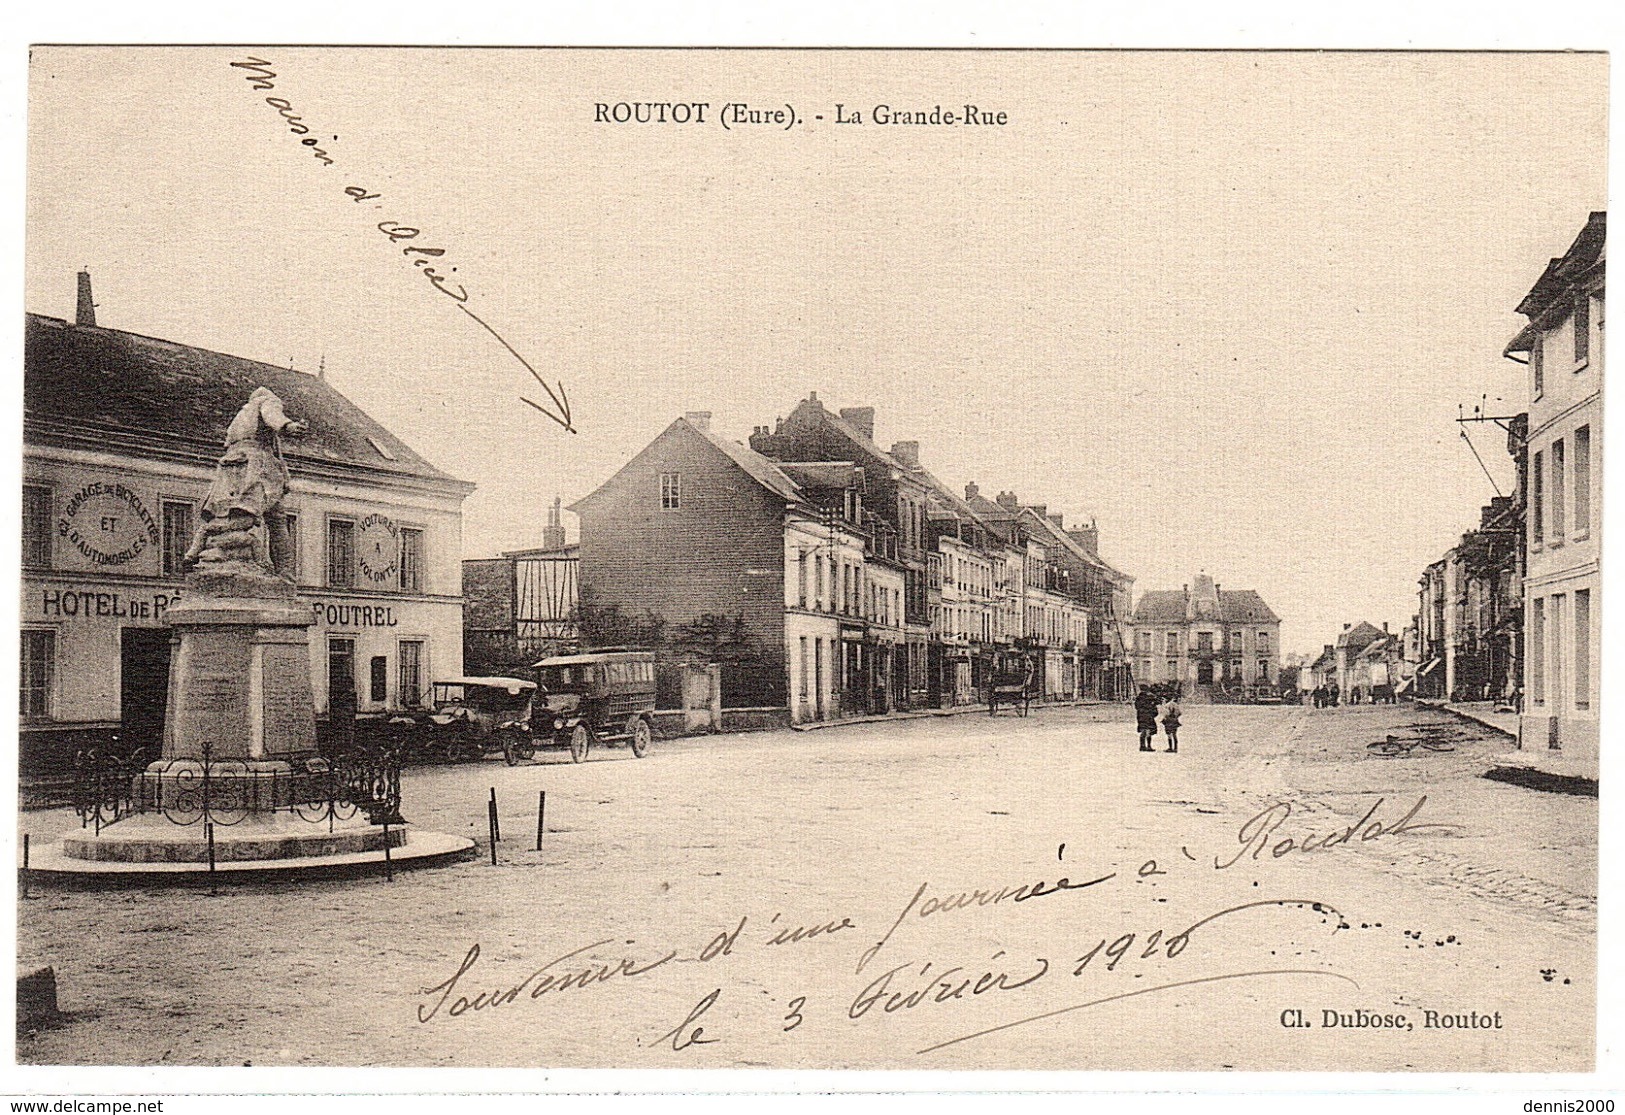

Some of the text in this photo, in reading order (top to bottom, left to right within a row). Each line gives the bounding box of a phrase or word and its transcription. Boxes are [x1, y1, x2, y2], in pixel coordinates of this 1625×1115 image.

[66, 482, 102, 517] GARAGE
[101, 516, 118, 532] ET
[360, 513, 397, 537] VOITURES
[130, 600, 149, 618] DE
[418, 938, 676, 1022] Souvenir
[783, 996, 806, 1032] 3
